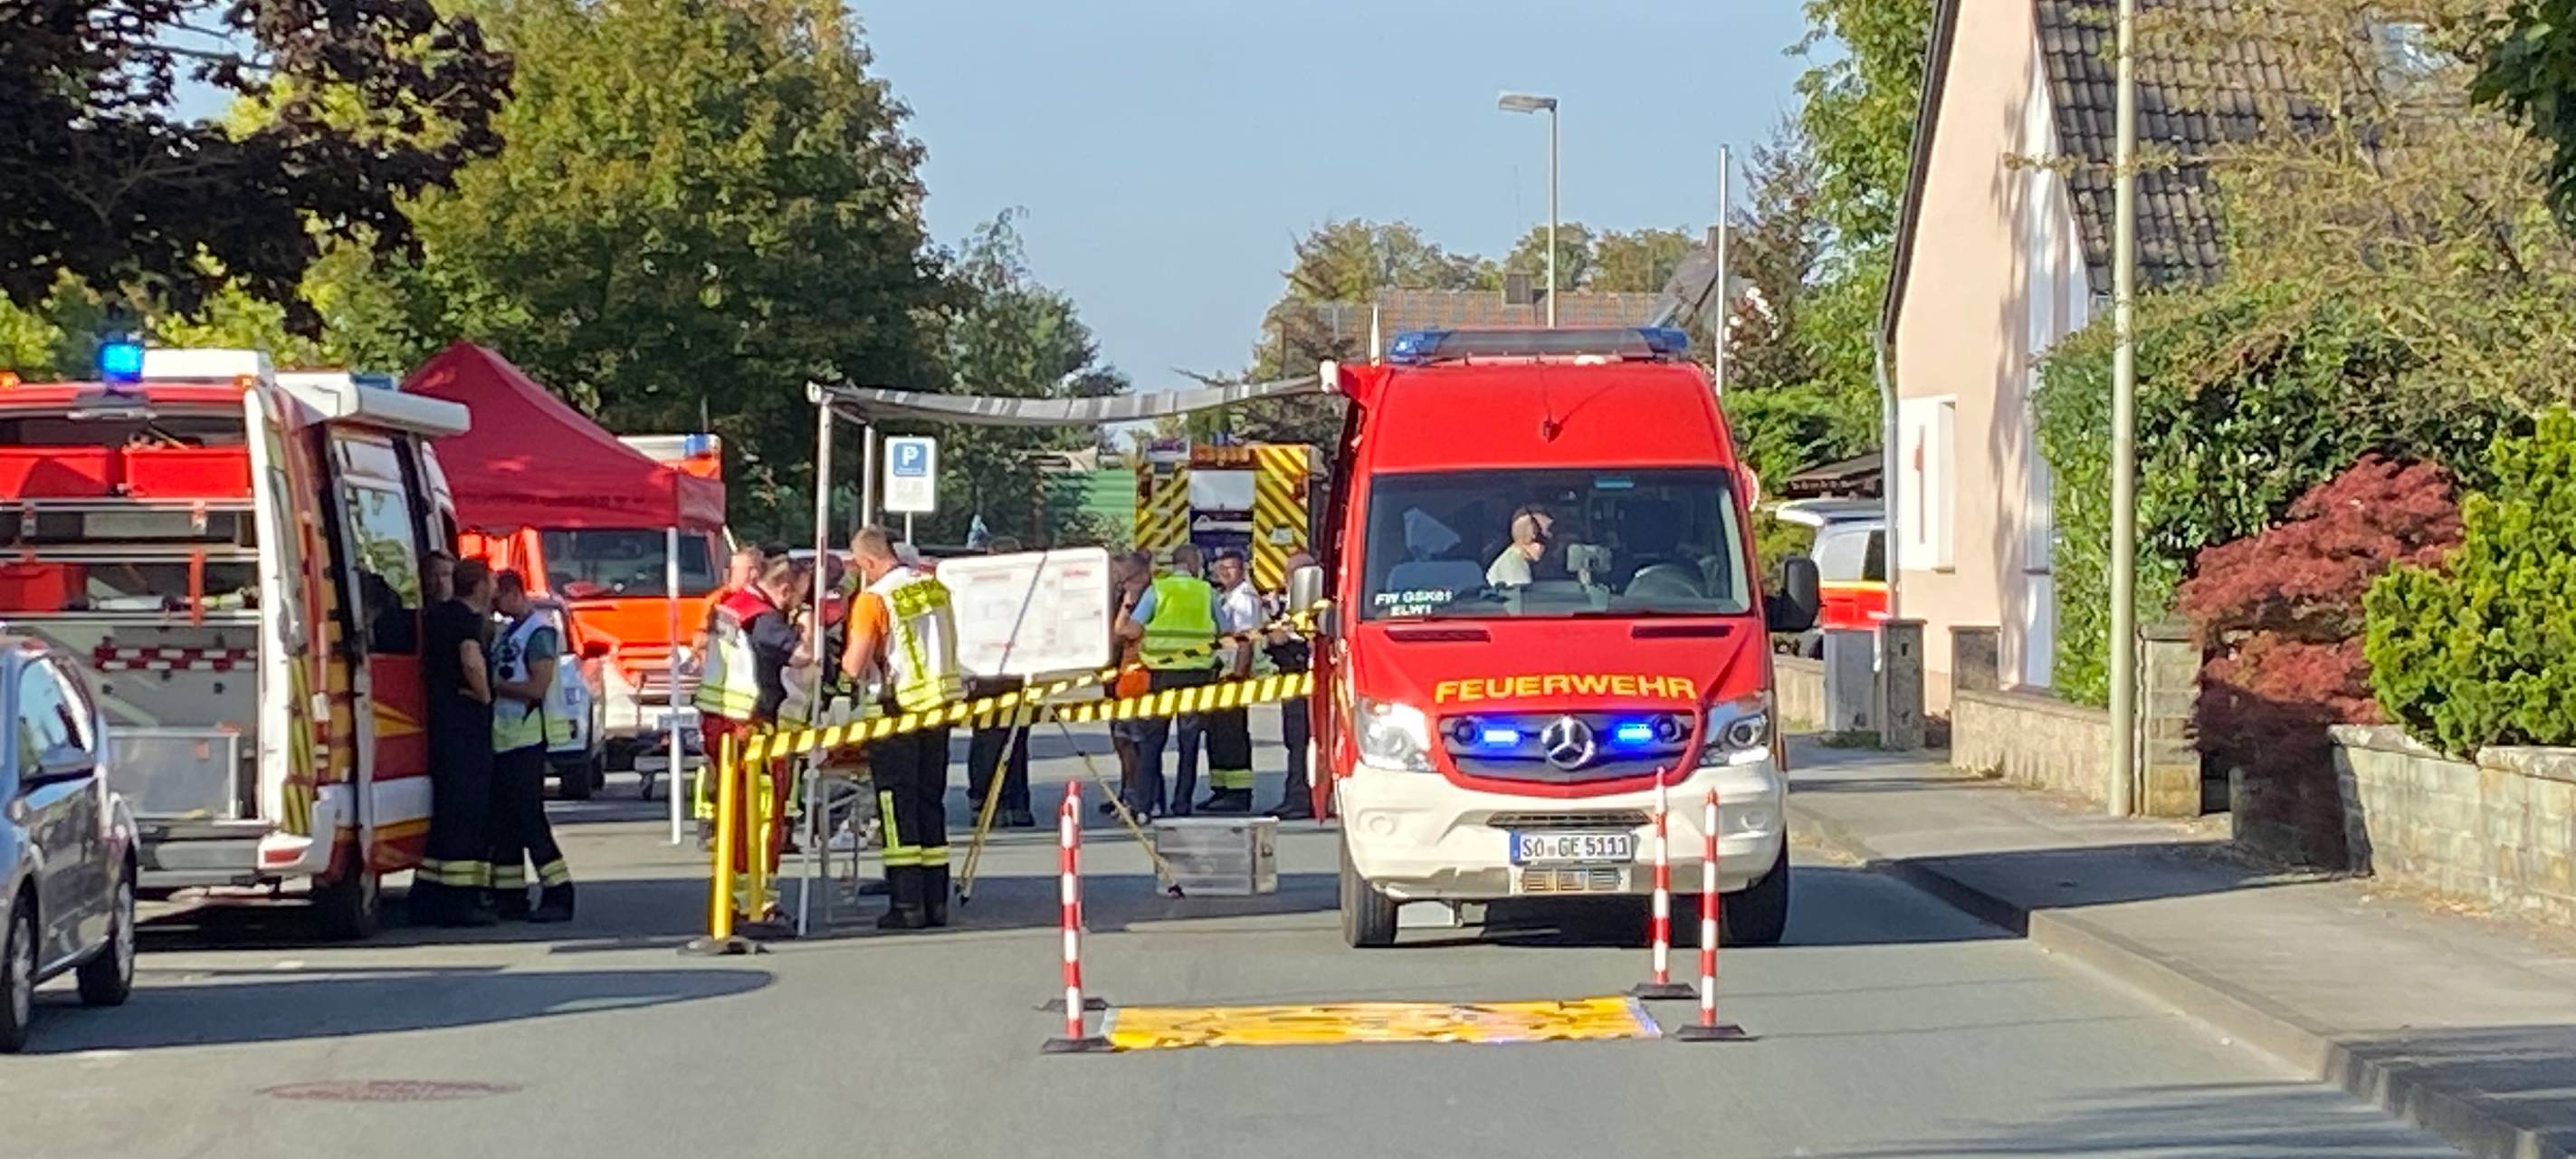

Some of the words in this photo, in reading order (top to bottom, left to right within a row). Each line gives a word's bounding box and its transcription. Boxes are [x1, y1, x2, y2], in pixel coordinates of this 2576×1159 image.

[902, 445, 919, 466] P
[1374, 593, 1399, 606] FW
[1435, 675, 1697, 704] FEUERWEHR
[1522, 838, 1544, 857] SO
[1585, 837, 1628, 856] 5111
